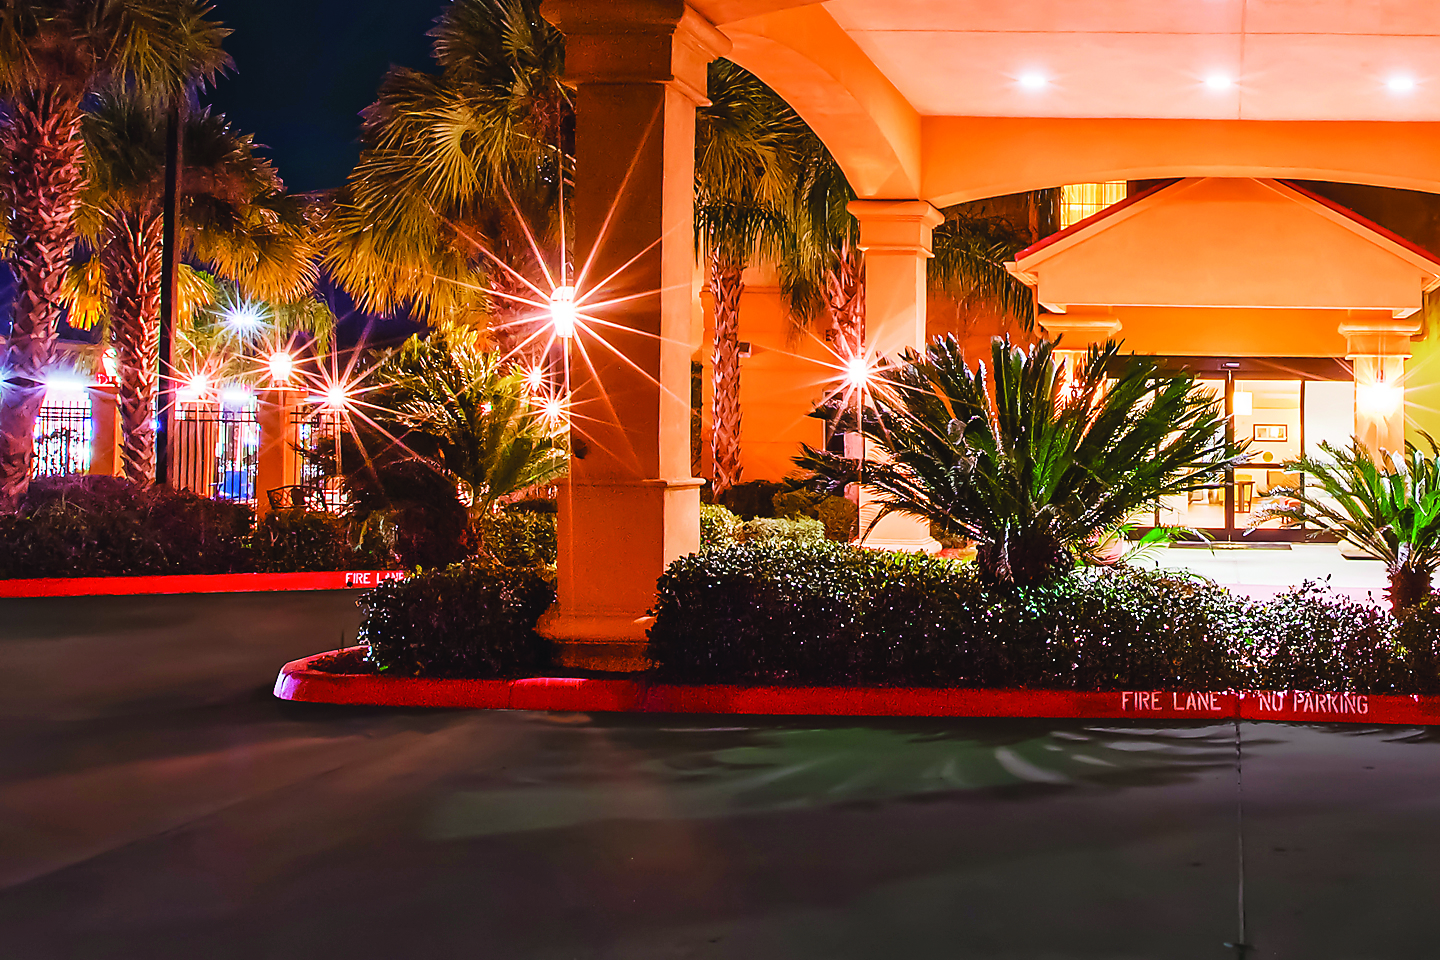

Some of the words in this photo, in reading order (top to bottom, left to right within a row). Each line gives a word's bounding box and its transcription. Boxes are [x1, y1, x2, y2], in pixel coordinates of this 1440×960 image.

[345, 572, 371, 584] FIRE
[1121, 691, 1163, 711] FIRE
[1173, 691, 1222, 711] LANE
[1259, 691, 1283, 712] NO
[1293, 692, 1369, 714] PARKING
